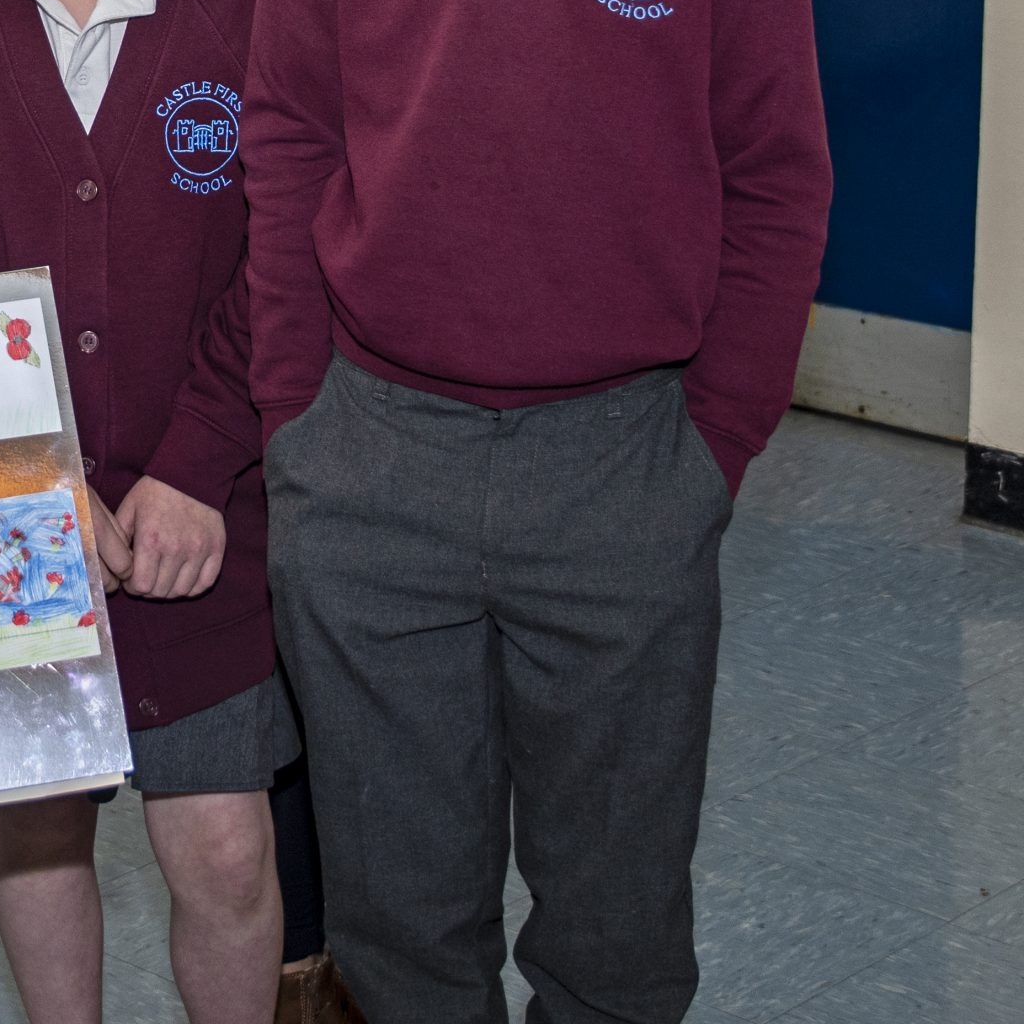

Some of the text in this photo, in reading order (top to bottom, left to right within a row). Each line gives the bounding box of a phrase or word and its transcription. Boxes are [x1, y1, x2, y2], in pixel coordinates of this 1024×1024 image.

[156, 81, 243, 117] CASTLE FIRS
[170, 172, 233, 194] SCHOOL
